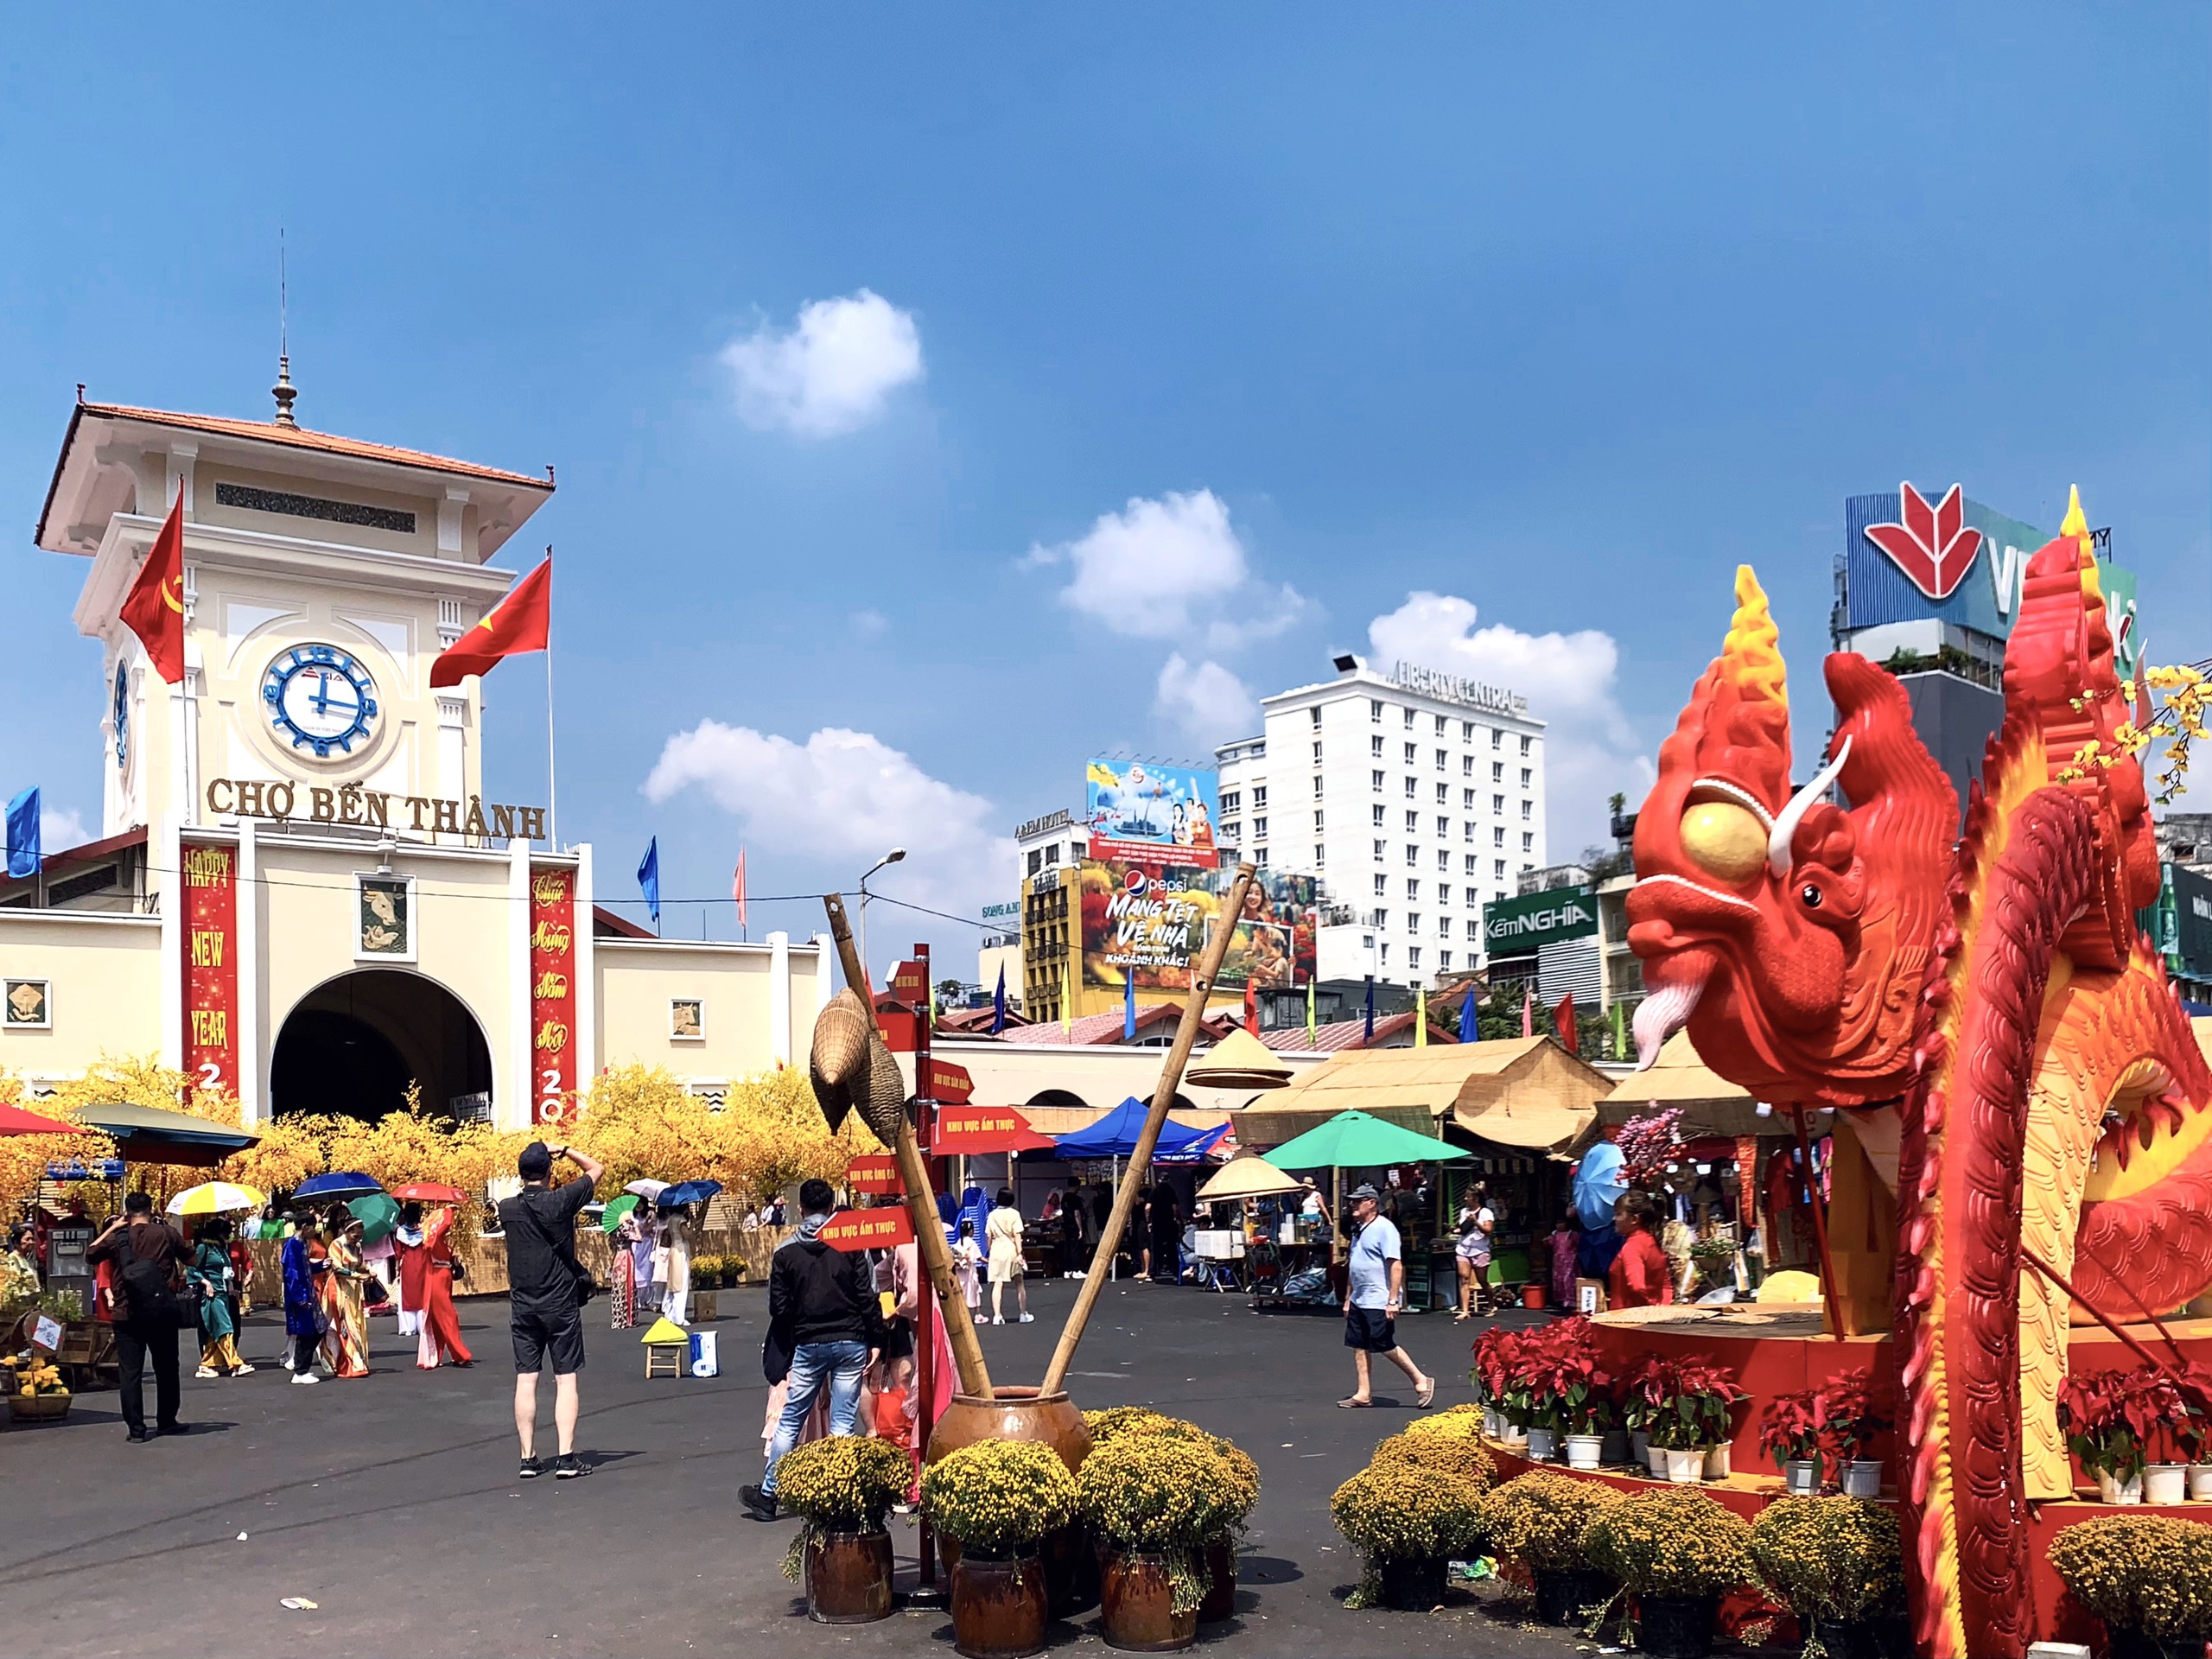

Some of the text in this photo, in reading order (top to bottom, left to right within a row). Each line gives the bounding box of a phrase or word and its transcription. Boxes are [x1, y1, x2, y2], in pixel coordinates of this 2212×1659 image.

[309, 645, 335, 664] 12
[264, 684, 280, 702] 9
[312, 738, 330, 759] 6
[207, 779, 546, 840] CHỢ BẾN THÀNH
[183, 849, 230, 888] HAPPY
[1147, 879, 1187, 893] pepsi
[1105, 893, 1199, 923] MANG TẾT
[191, 931, 224, 967] NEW
[531, 919, 570, 957] Mừng
[1148, 922, 1192, 949] NHÀ
[534, 971, 568, 999] Năm
[190, 1011, 228, 1050] YEAR
[946, 1121, 963, 1133] KHU
[964, 1119, 980, 1134] VỰC
[995, 1119, 1015, 1133] THỰC
[823, 1227, 840, 1240] KHU
[841, 1224, 858, 1240] VỰC
[874, 1220, 896, 1236] THỰC
